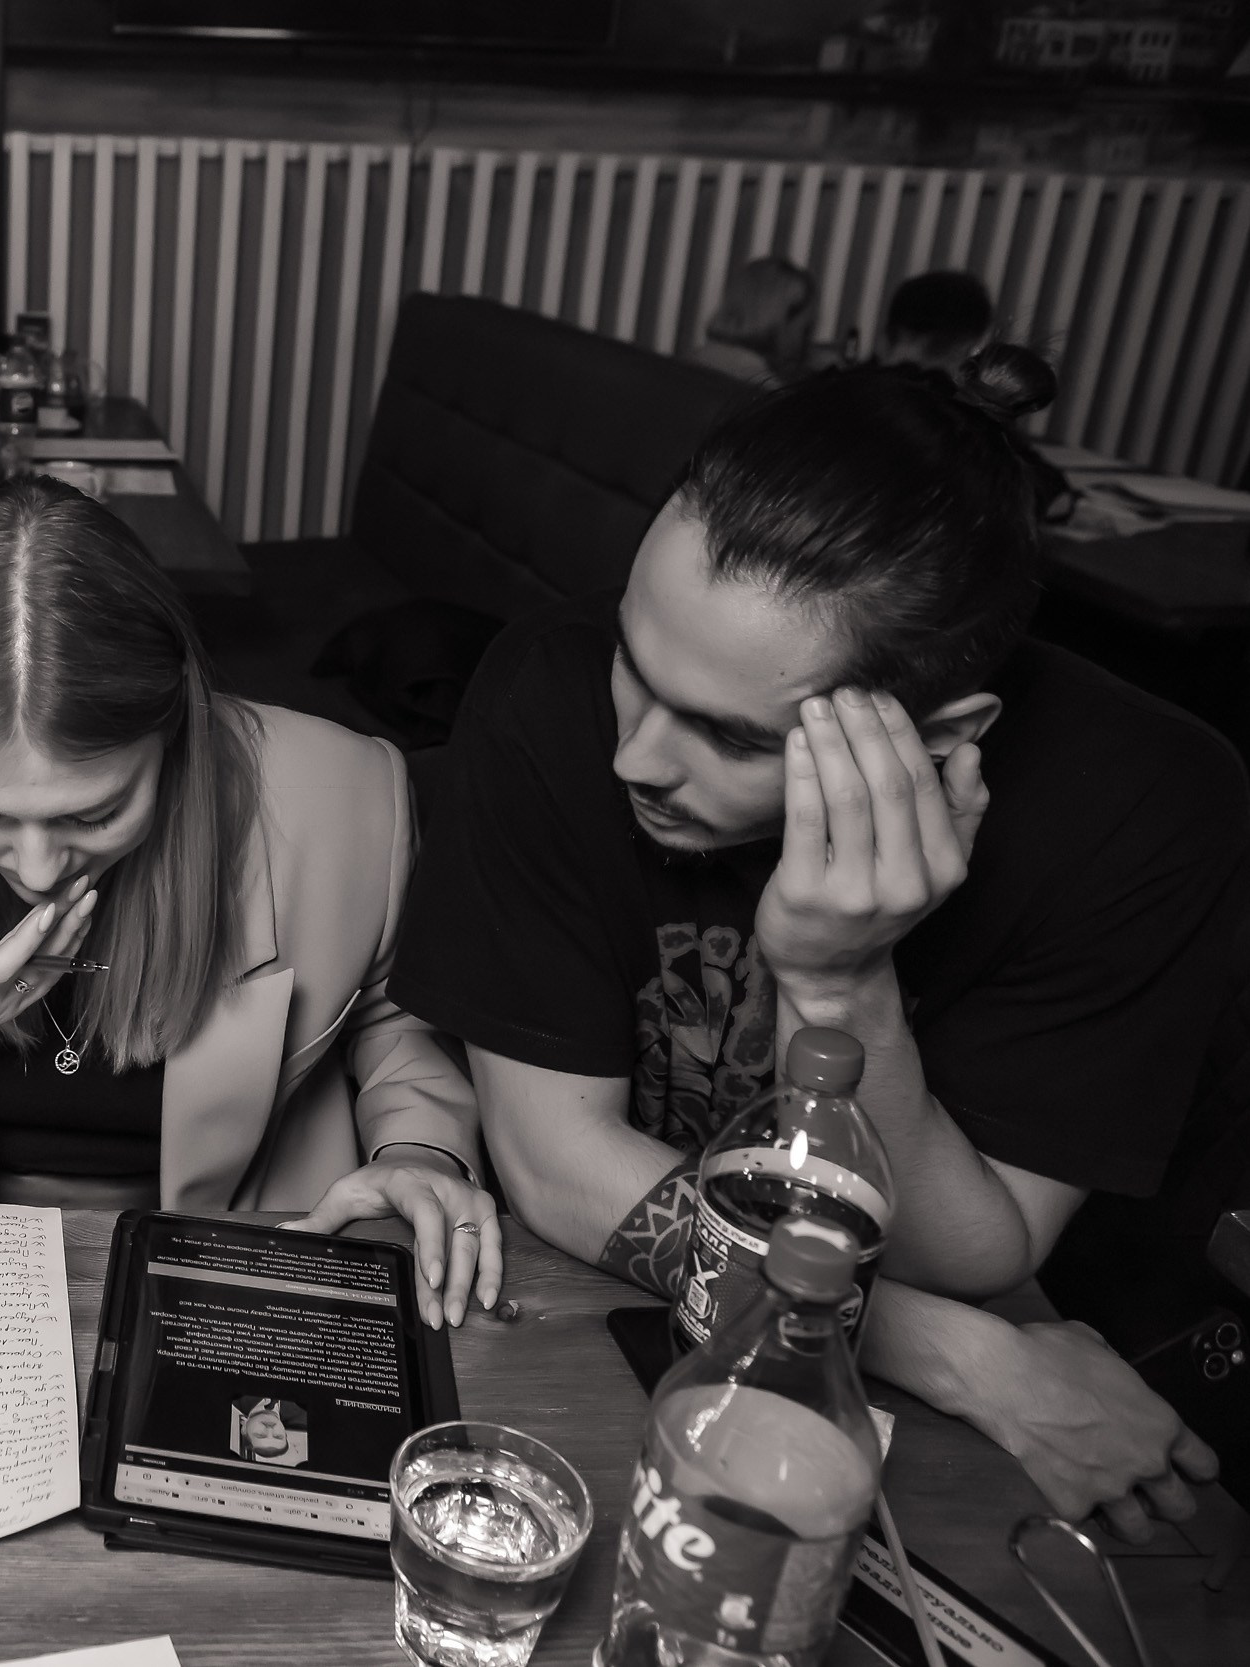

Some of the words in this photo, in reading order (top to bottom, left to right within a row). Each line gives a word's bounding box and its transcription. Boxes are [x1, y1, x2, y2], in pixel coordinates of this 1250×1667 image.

[155, 1254, 179, 1262] после
[211, 1261, 234, 1270] конце
[259, 1268, 294, 1278] мужчины
[294, 1273, 316, 1281] голос
[377, 1270, 389, 1278] Вы
[316, 1276, 341, 1284] звучит
[192, 1301, 207, 1309] как
[225, 1306, 249, 1315] после
[249, 1308, 272, 1318] сразу
[271, 1312, 297, 1321] газете
[232, 1321, 256, 1331] Груды
[303, 1316, 342, 1327] освещали
[341, 1321, 358, 1329] уже
[235, 1329, 251, 1337] уже
[287, 1329, 323, 1339] изучаете
[371, 1325, 386, 1334] Мы
[165, 1334, 191, 1344] время
[251, 1331, 266, 1339] вот
[365, 1331, 381, 1340] уже
[381, 1334, 395, 1342] Тут
[173, 1343, 193, 1352] свой
[313, 1339, 324, 1347] до
[324, 1341, 346, 1350] было
[368, 1339, 396, 1349] другой
[199, 1347, 215, 1355] вас
[231, 1344, 244, 1352] Он
[346, 1344, 361, 1352] что
[372, 1348, 388, 1356] Это
[331, 1350, 355, 1359] столе
[175, 1359, 186, 1367] из
[325, 1357, 349, 1366] висит
[349, 1360, 364, 1368] где
[361, 1354, 397, 1365] копается
[185, 1361, 211, 1371] кто-то
[211, 1364, 223, 1372] ли
[222, 1366, 240, 1375] был
[254, 1362, 270, 1371] Вас
[306, 1369, 318, 1377] на
[318, 1371, 346, 1381] газеты
[363, 1370, 399, 1380] который
[306, 1377, 347, 1389] редакцию
[353, 1384, 386, 1395] входите
[386, 1389, 400, 1397] Вы
[633, 1465, 717, 1572] ite
